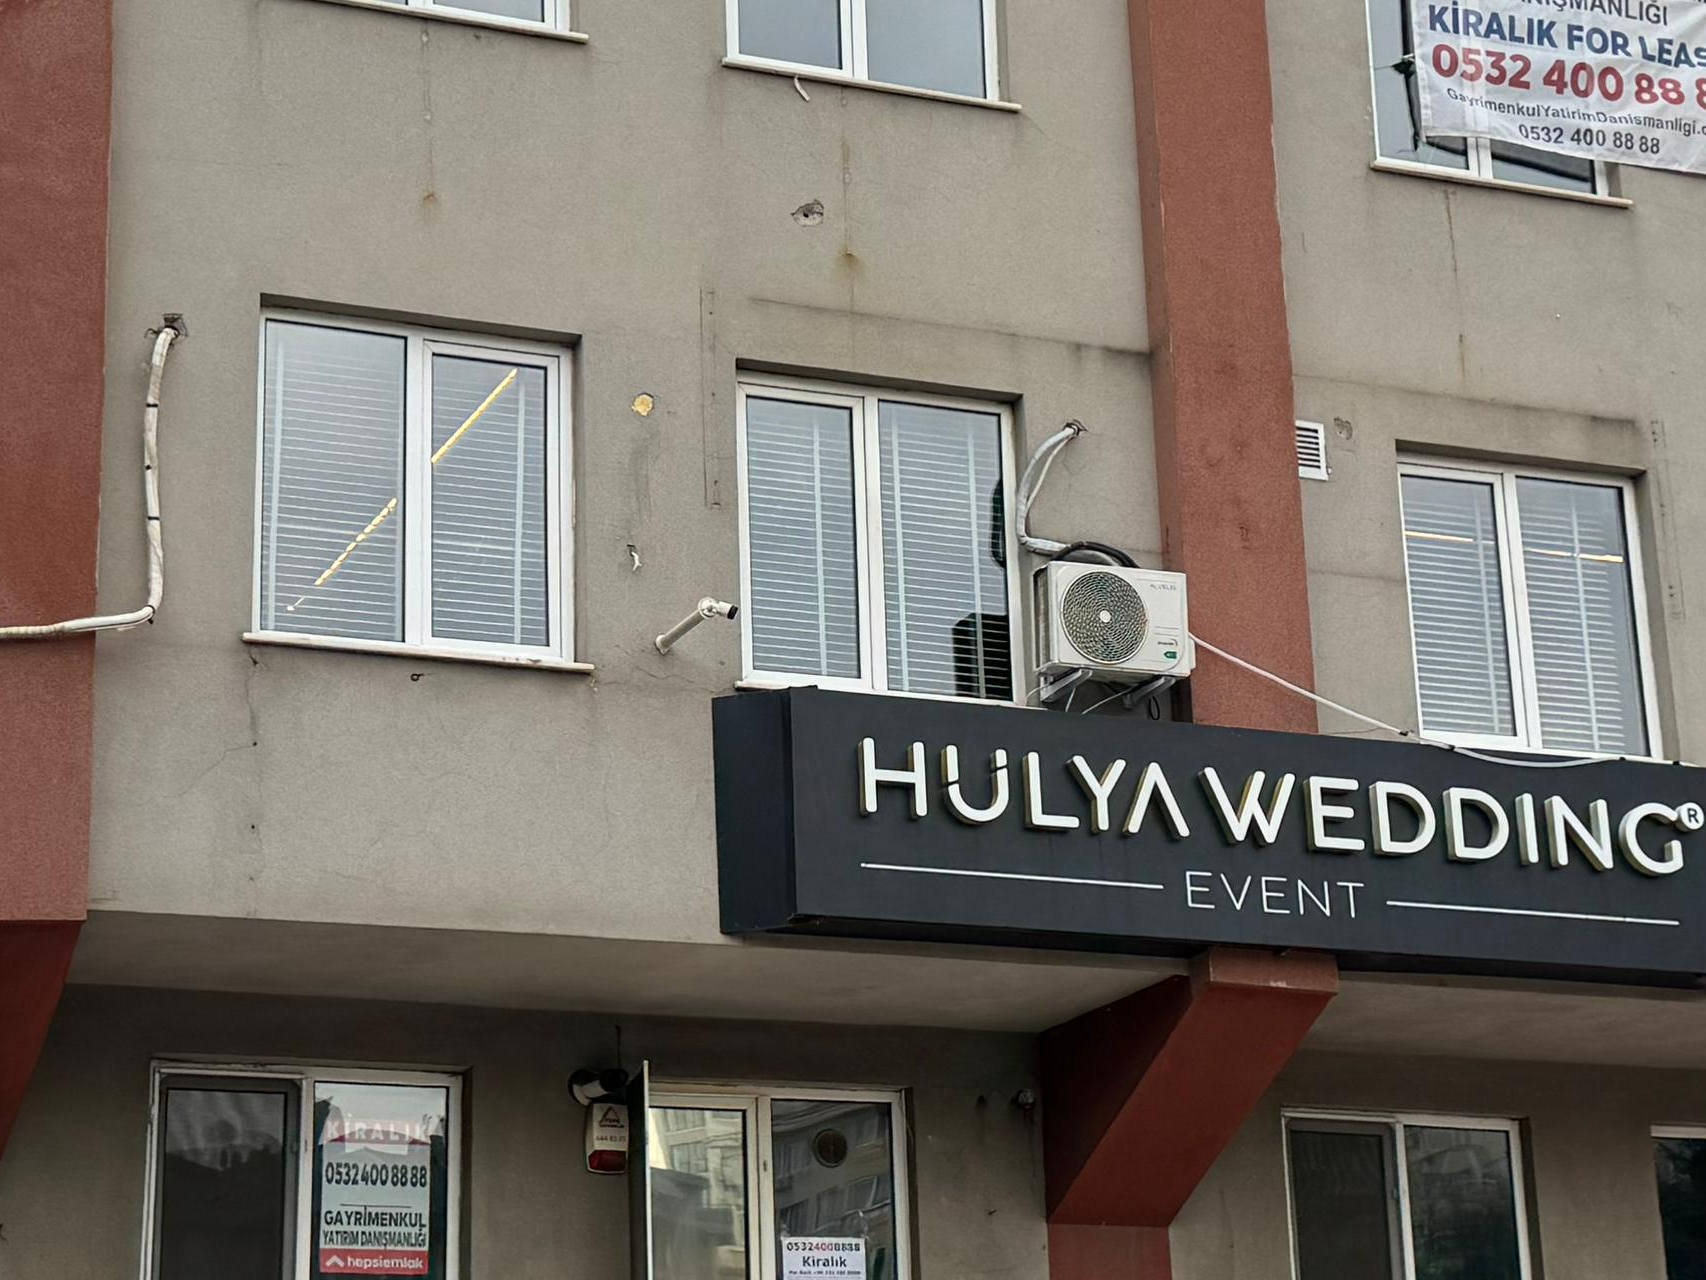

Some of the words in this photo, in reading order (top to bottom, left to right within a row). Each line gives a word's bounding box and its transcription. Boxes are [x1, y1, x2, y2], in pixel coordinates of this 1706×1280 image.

[1428, 0, 1558, 49] KİRALIK
[1567, 24, 1632, 58] FOR
[1431, 43, 1533, 91] 0532
[1542, 58, 1625, 102] 400
[1634, 72, 1686, 106] 88
[1518, 123, 1565, 146] 0532
[1570, 126, 1607, 149] 400
[1611, 130, 1636, 152] 88
[1638, 133, 1661, 155] 88
[1184, 871, 1365, 919] EVENT
[325, 1162, 359, 1186] 0532
[360, 1163, 389, 1186] 400
[390, 1164, 408, 1187] 88
[410, 1165, 428, 1188] 88
[324, 1205, 427, 1229] GAYRİMENKUL
[802, 1255, 848, 1268] Kiralık
